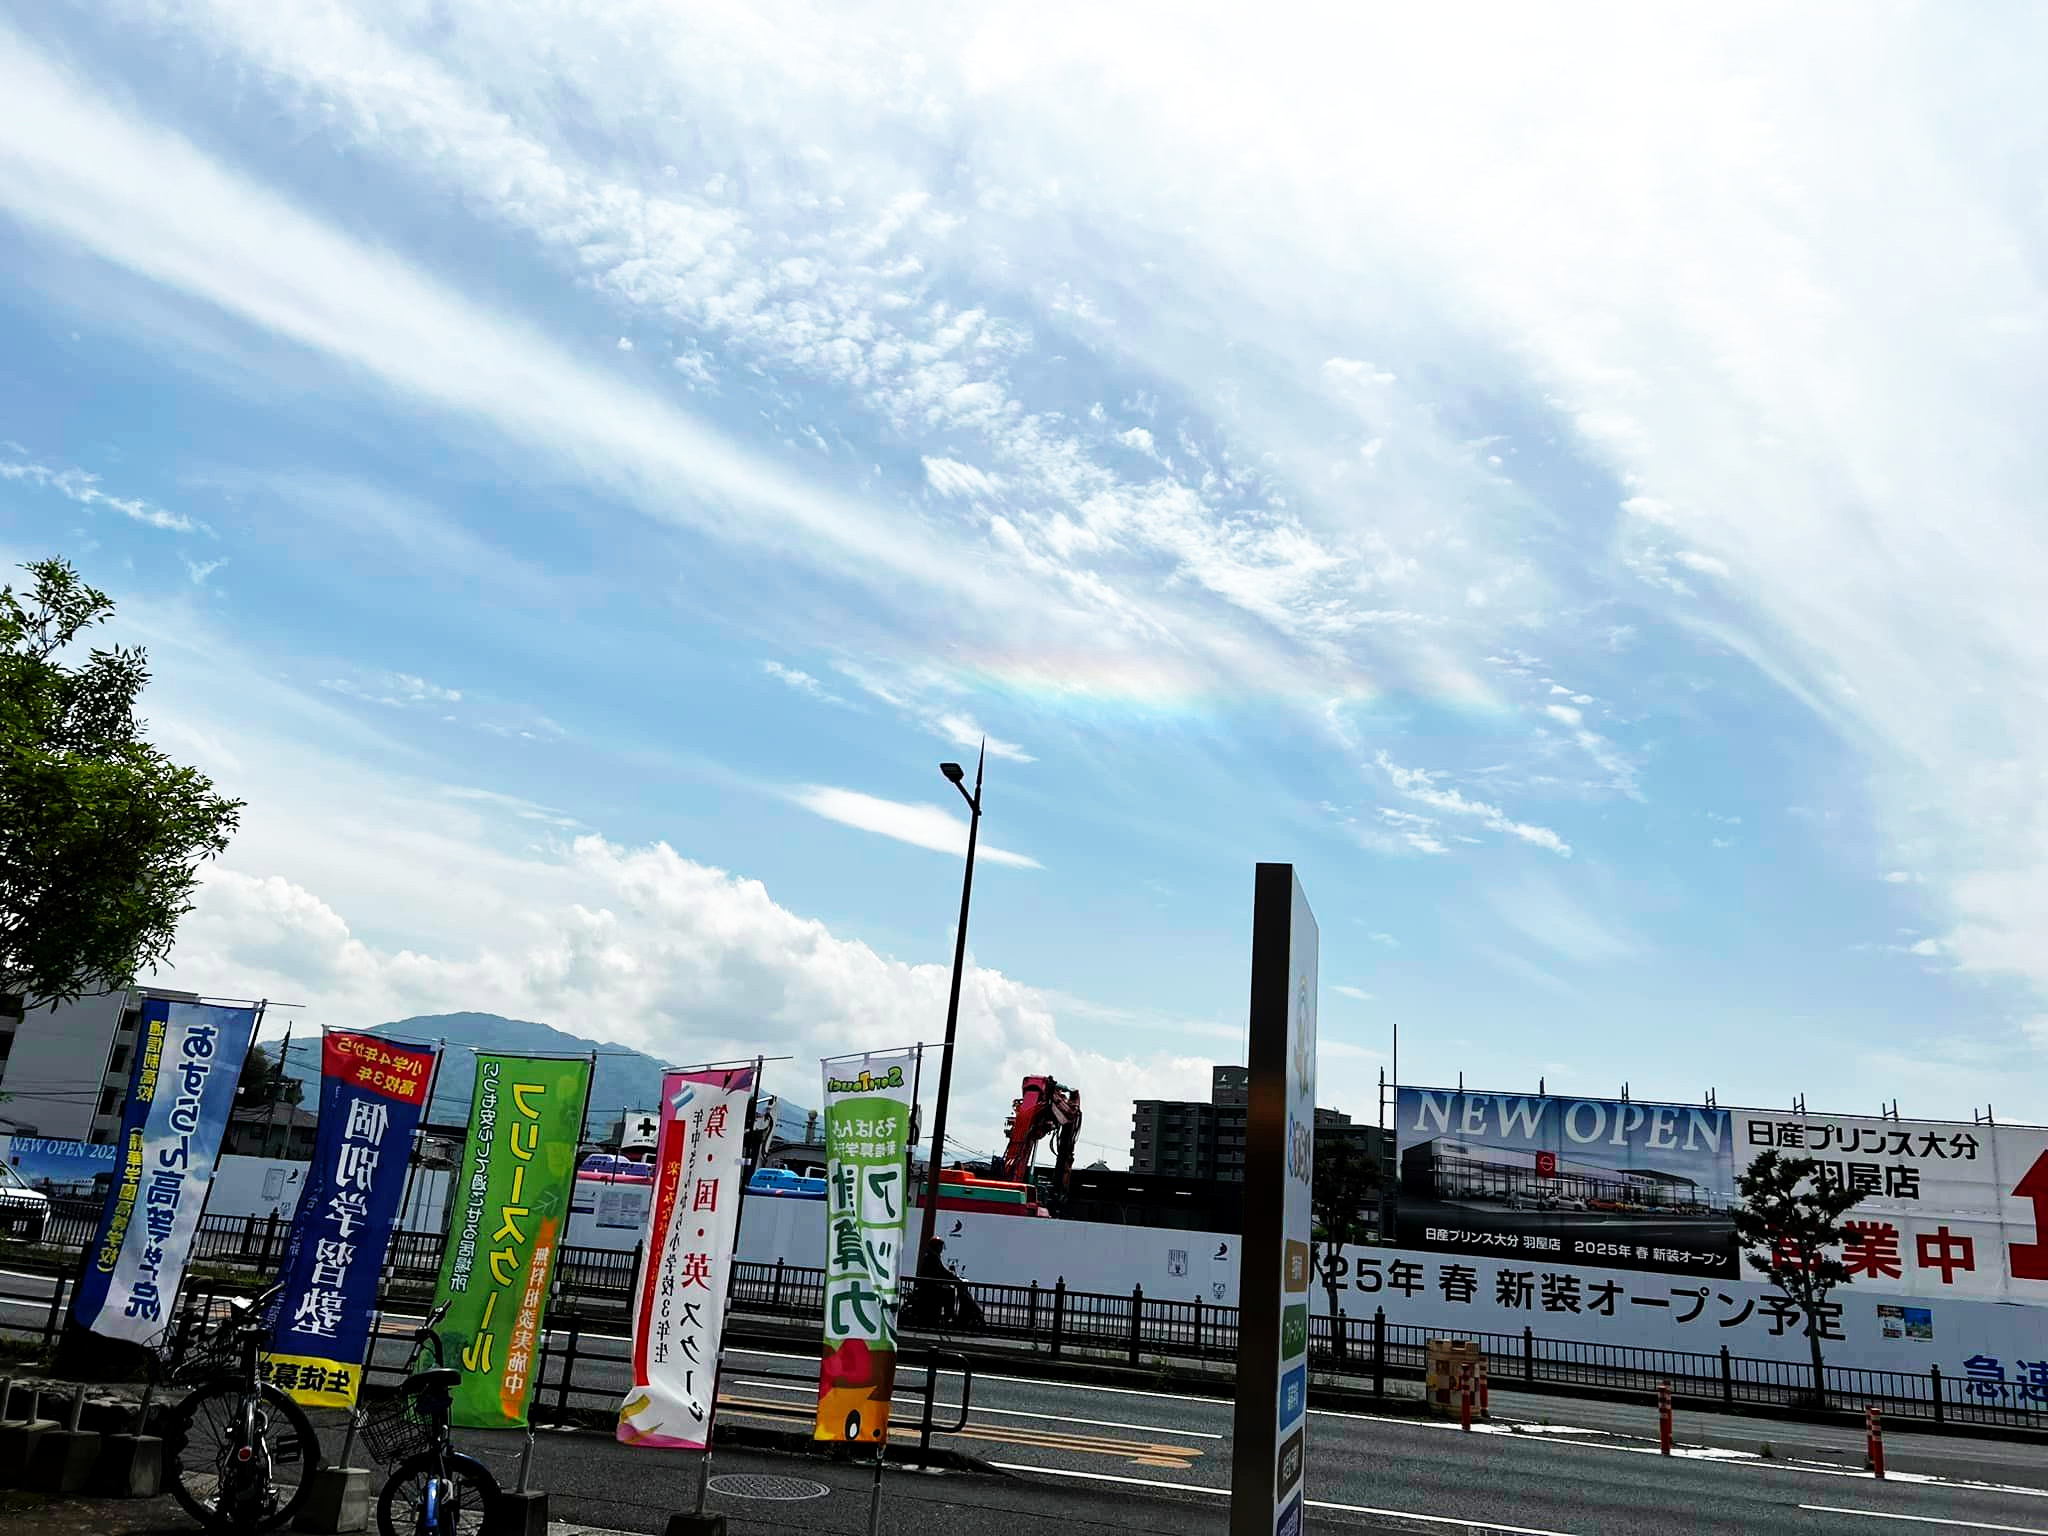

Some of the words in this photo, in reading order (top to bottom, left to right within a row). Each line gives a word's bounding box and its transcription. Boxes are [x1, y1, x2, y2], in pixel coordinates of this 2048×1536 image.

[1413, 1092, 1549, 1139] NEW
[1565, 1100, 1730, 1152] OPEN
[1748, 1119, 1980, 1160] 日産プリンス大分
[10, 1136, 46, 1153] NEW
[47, 1140, 88, 1157] OPEN
[89, 1145, 117, 1160] 202
[1808, 1159, 1920, 1200] 羽屋店
[1426, 1228, 1519, 1247] 日産プリンス大分
[1523, 1235, 1561, 1251] 羽屋店
[1574, 1241, 1631, 1258] 2025年
[1635, 1246, 1649, 1260] 春
[1653, 1248, 1728, 1266] 新装オープン
[1311, 1255, 1424, 1298] 25年
[1439, 1264, 1478, 1305] 春
[1496, 1269, 1846, 1341] 新装オープン予定
